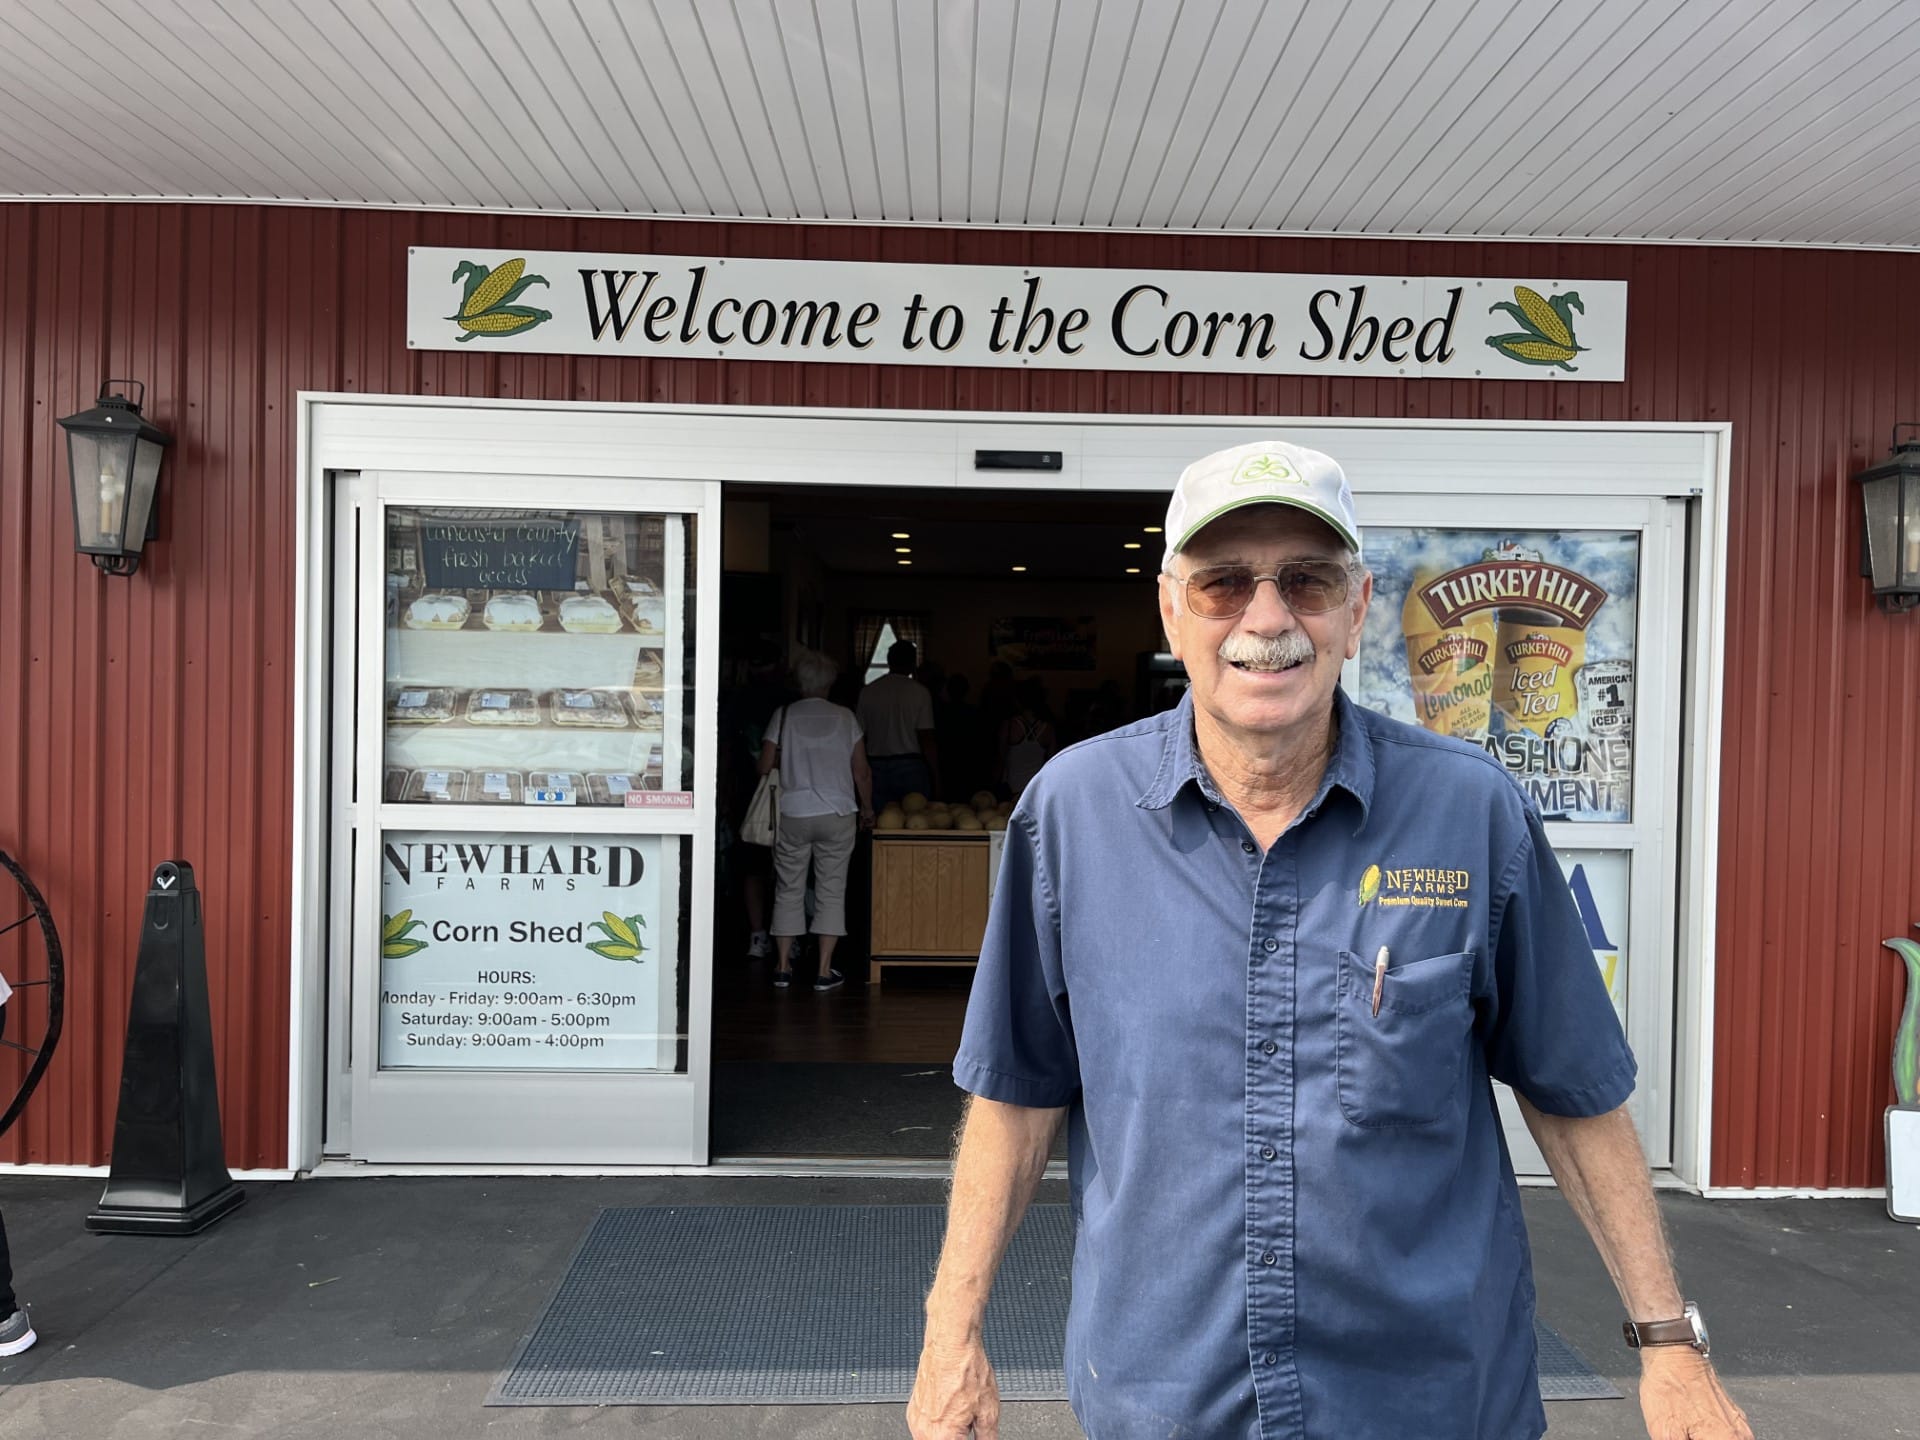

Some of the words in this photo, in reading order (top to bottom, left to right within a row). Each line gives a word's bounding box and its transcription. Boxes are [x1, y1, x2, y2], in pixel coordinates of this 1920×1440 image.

[578, 266, 880, 349] Welcome
[902, 293, 965, 352] to
[988, 276, 1090, 355] the
[1110, 284, 1278, 360] Corn
[1298, 285, 1465, 364] Shed
[1429, 568, 1536, 614] TURKEY
[1535, 568, 1591, 619] HILL
[1422, 642, 1462, 669] TURKEY
[1463, 641, 1484, 658] HILL
[1508, 642, 1548, 659] TURKEY
[1548, 643, 1569, 663] HILL
[1511, 664, 1558, 691] Iced
[1522, 691, 1560, 716] Tea
[1597, 684, 1625, 707] #1
[1592, 715, 1619, 727] ICED
[628, 794, 642, 804] NO
[646, 795, 689, 805] SMOKING
[1525, 779, 1619, 812] MENT
[384, 843, 645, 887] NEWHARD
[437, 877, 575, 890] FARMS
[1386, 869, 1469, 890] NEWHARD
[1402, 883, 1455, 894] FARMS
[1454, 898, 1468, 907] Corn
[433, 920, 498, 942] Corn
[508, 920, 582, 943] Shed
[478, 971, 535, 984] HOURS:
[449, 991, 499, 1007] Friday:
[504, 992, 563, 1005] 9:00am
[577, 992, 636, 1008] 6:30pm
[401, 1012, 472, 1028] Saturday:
[478, 1012, 537, 1026] 9:00am
[551, 1013, 610, 1028] 5:00pm
[407, 1033, 467, 1048] Sunday:
[471, 1033, 531, 1047] 9:00am
[545, 1034, 604, 1049] 4:00pm
